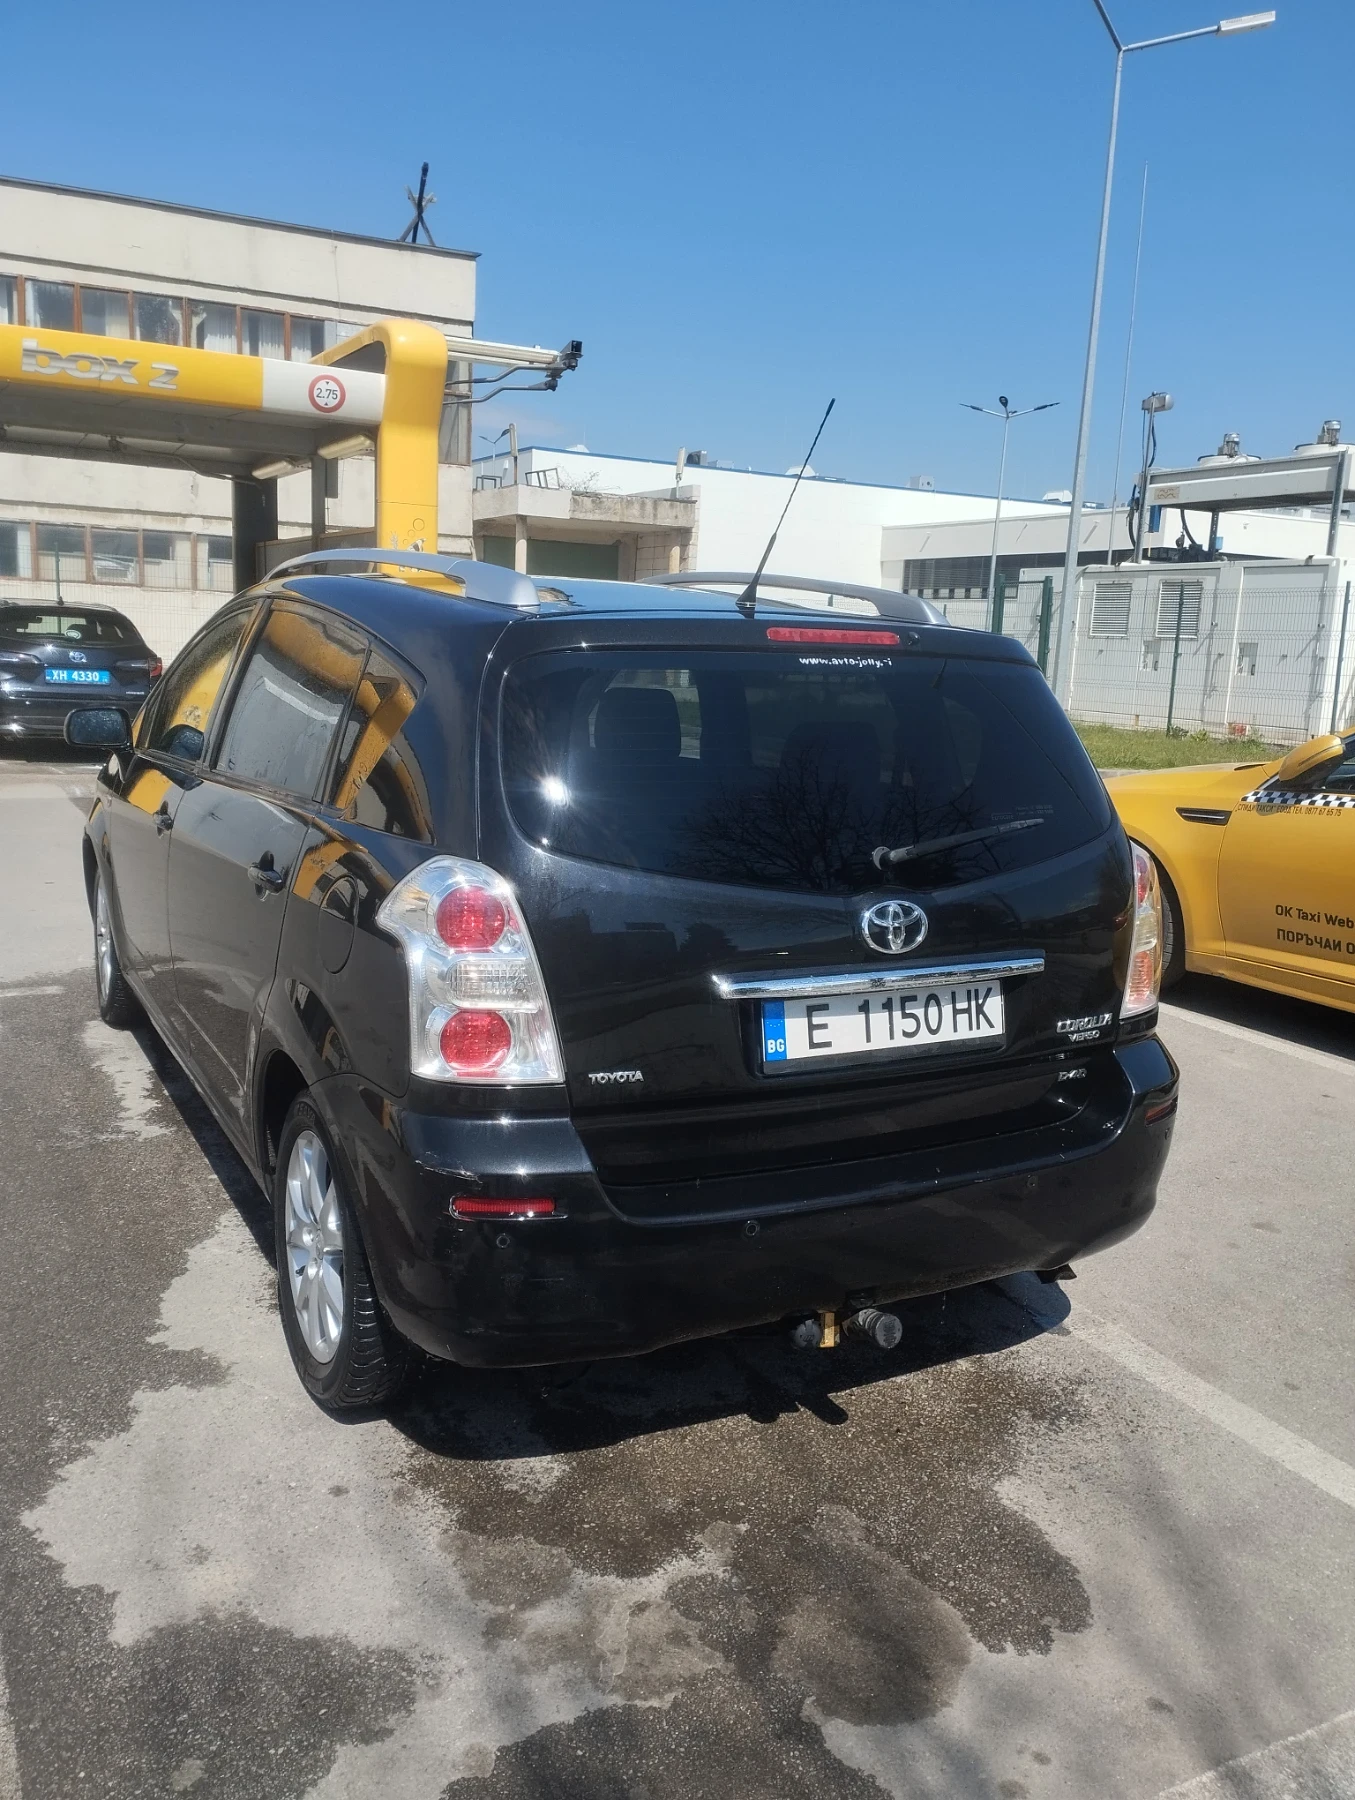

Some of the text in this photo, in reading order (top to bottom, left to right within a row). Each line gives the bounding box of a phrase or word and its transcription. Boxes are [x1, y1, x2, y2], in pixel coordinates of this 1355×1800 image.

[21, 337, 180, 391] box 2
[315, 386, 339, 401] 2.75
[52, 669, 67, 680] XH
[71, 670, 100, 682] 4330
[1304, 807, 1318, 816] 0877
[1275, 904, 1355, 929] OK Taxi Web
[805, 986, 996, 1050] E 1150 HK
[1067, 1029, 1100, 1042] VERSO
[767, 1038, 786, 1054] BG
[588, 1070, 644, 1085] TOYOTA
